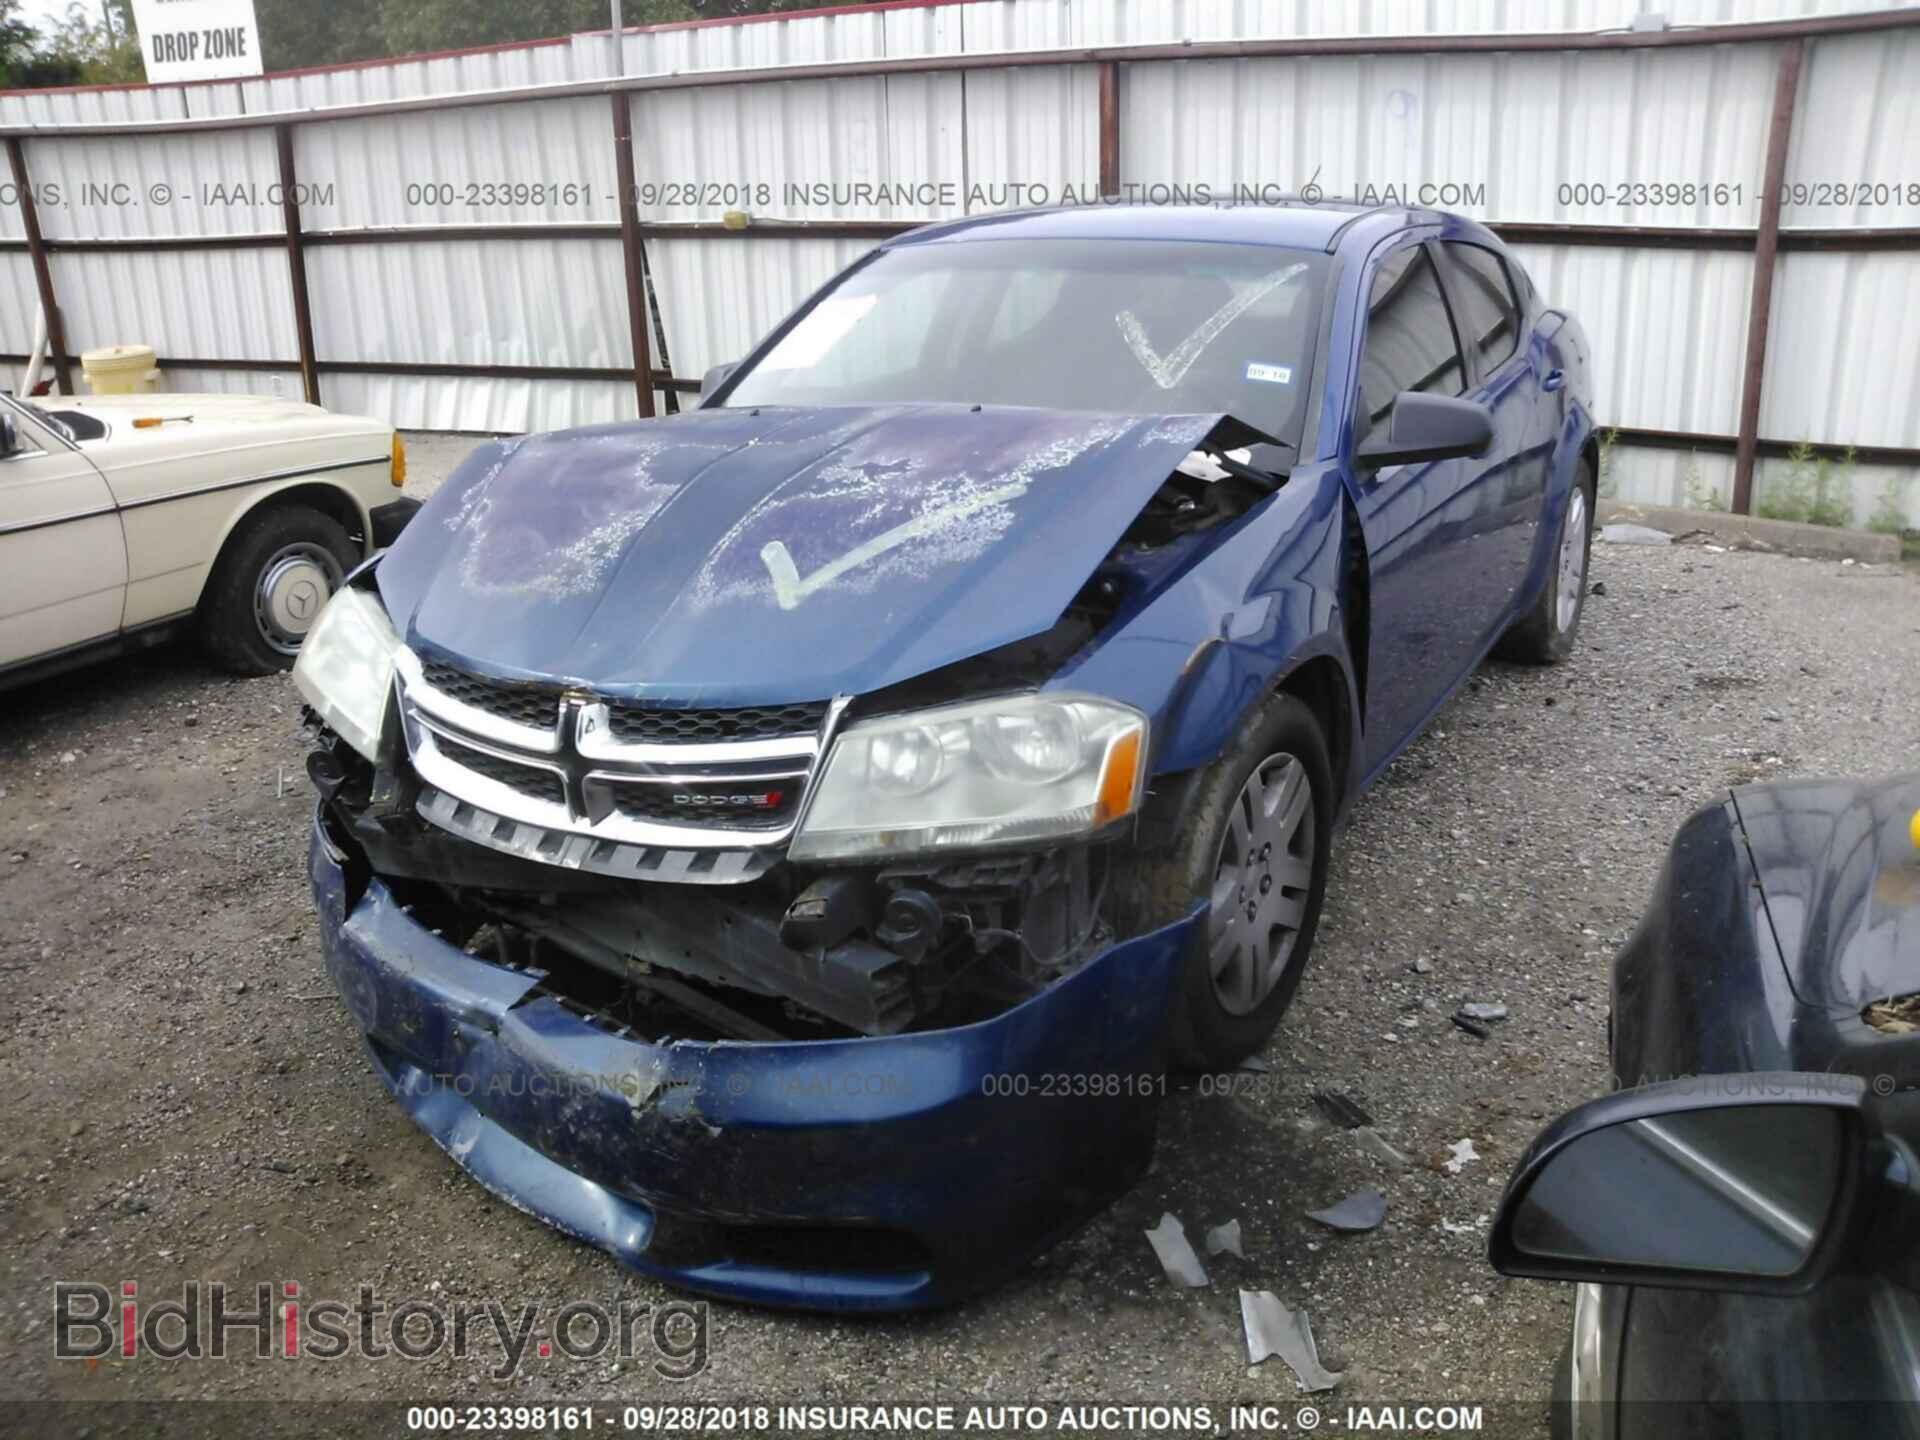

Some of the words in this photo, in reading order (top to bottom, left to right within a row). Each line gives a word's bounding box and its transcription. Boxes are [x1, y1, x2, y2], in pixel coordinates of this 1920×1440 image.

[152, 31, 199, 63] DROP
[202, 26, 247, 60] ZONE
[672, 794, 768, 805] DODGE
